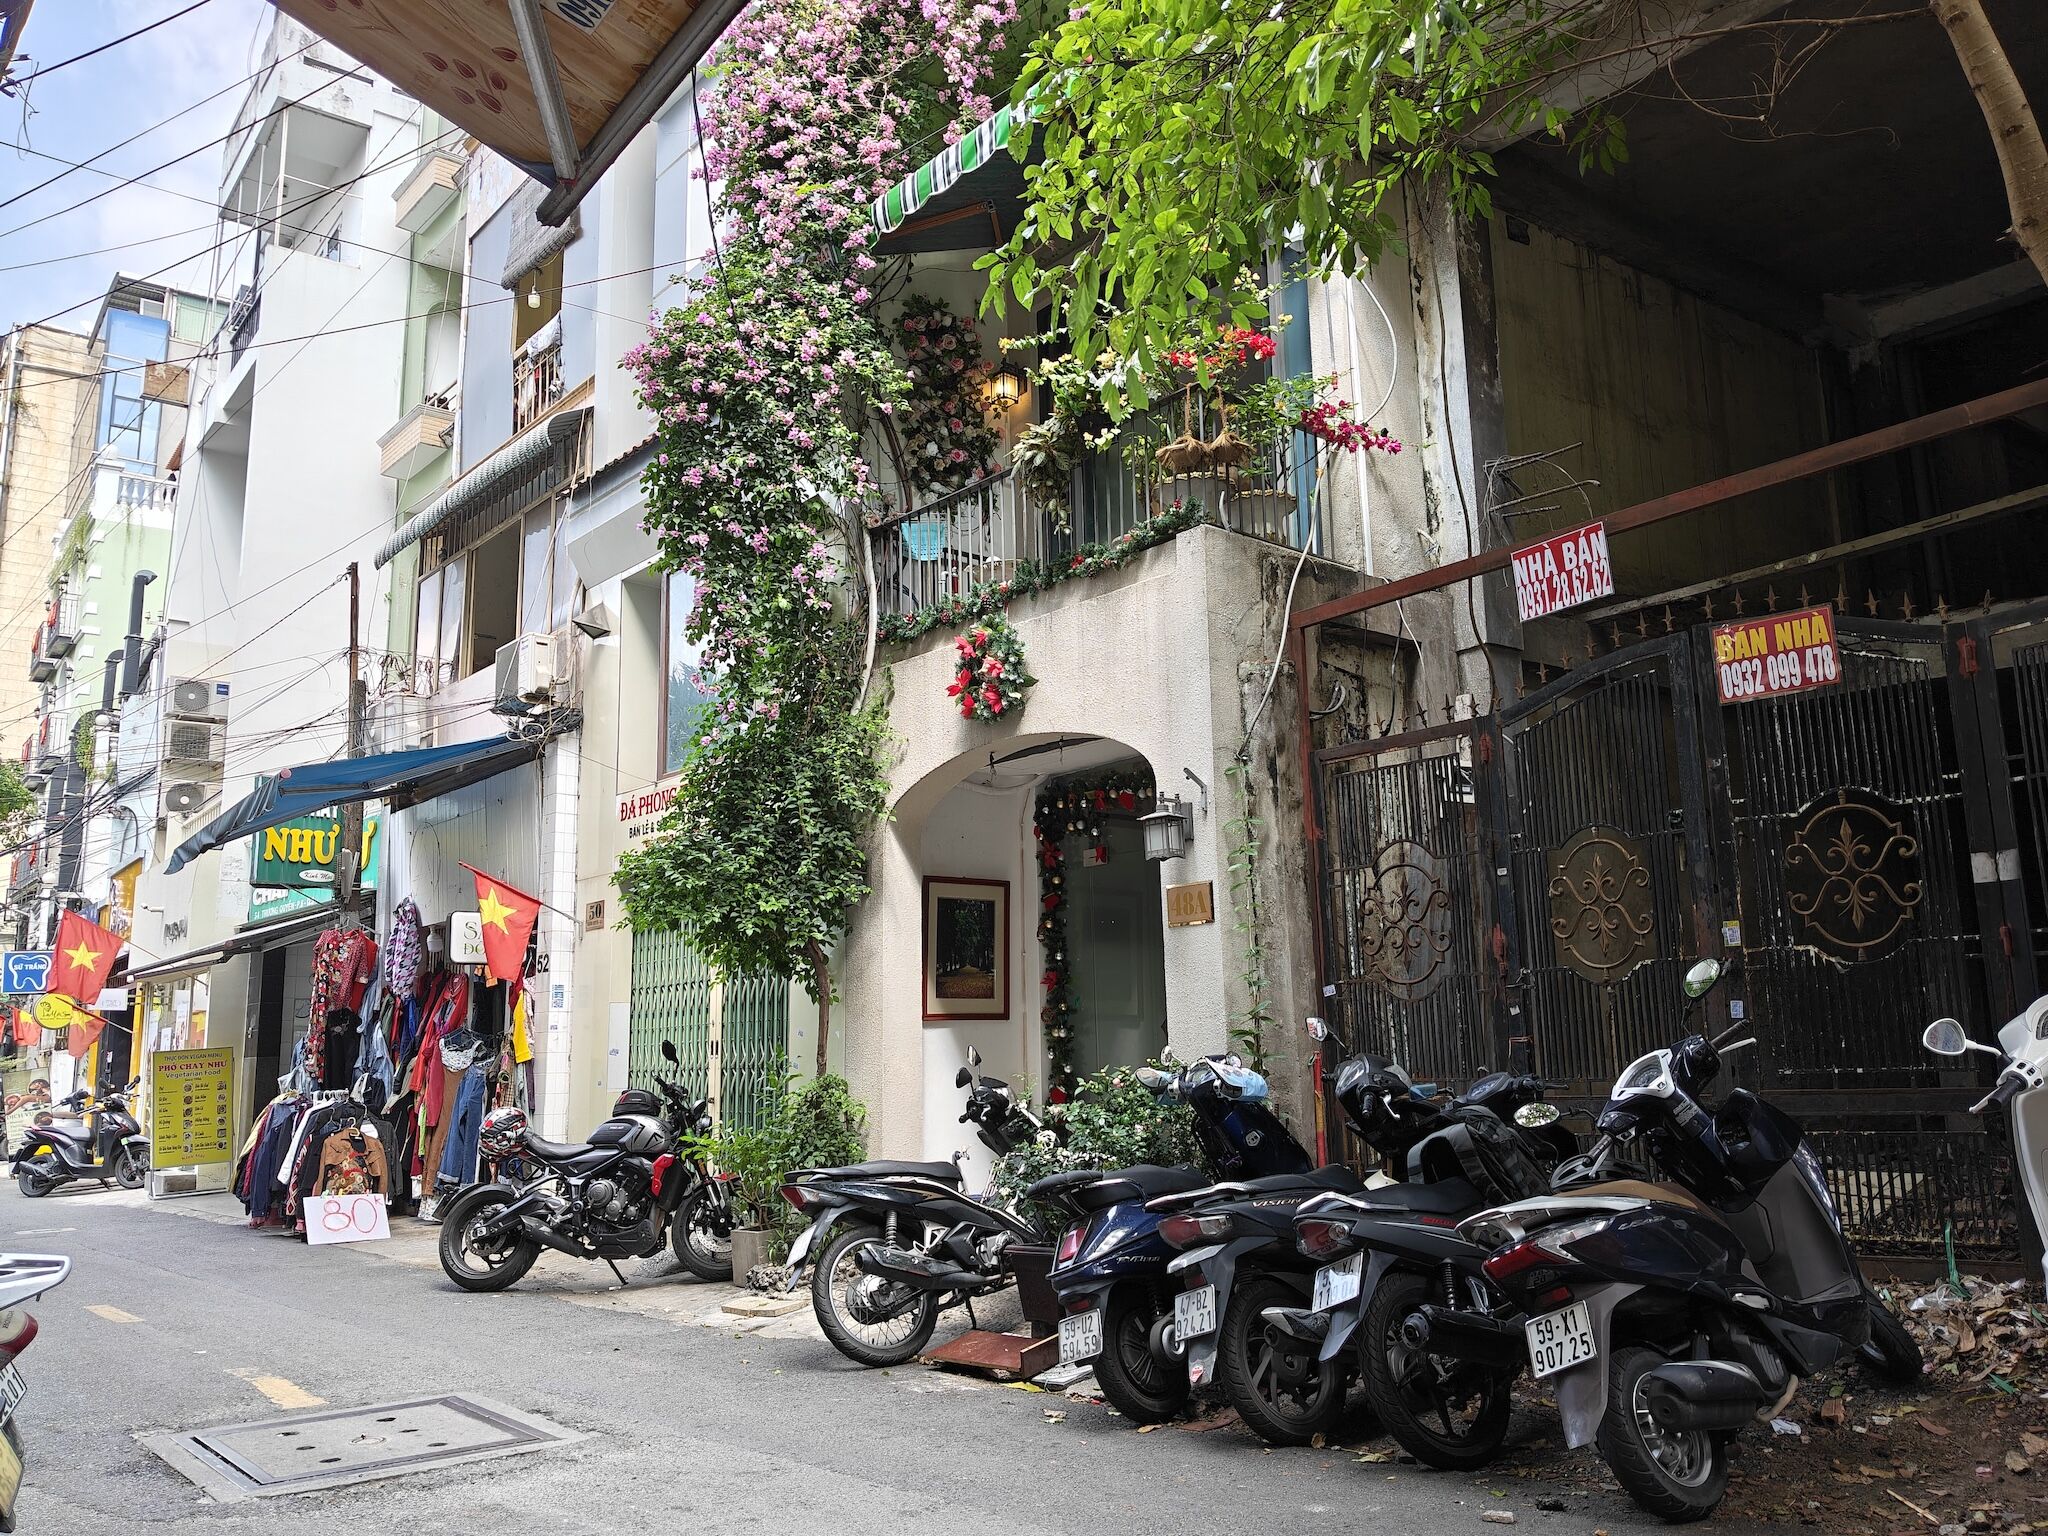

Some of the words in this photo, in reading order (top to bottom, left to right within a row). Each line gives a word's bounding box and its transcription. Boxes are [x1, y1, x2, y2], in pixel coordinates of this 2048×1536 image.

[1513, 543, 1558, 587] NHÀ
[1562, 530, 1606, 571] BÁN
[1518, 558, 1612, 620] 0931.28.62.62
[1716, 626, 1768, 663] BÁN
[1774, 611, 1830, 652] NHÀ
[1720, 658, 1765, 698] 0932
[1766, 651, 1801, 690] 099
[1805, 645, 1836, 683] 478
[620, 795, 636, 822] ĐÁ
[263, 823, 341, 865] NHƯ
[589, 903, 602, 920] 50
[1171, 889, 1208, 917] 48A
[537, 953, 550, 973] 52
[165, 1071, 203, 1079] Vegetarian
[179, 1062, 205, 1071] CHAY
[1180, 1290, 1208, 1317] 47-B2
[1064, 1315, 1094, 1341] 59-U2
[1176, 1310, 1213, 1339] 924.21
[1535, 1309, 1578, 1345] 59-X1
[1062, 1334, 1098, 1362] 594.59
[1535, 1332, 1591, 1373] 907.25
